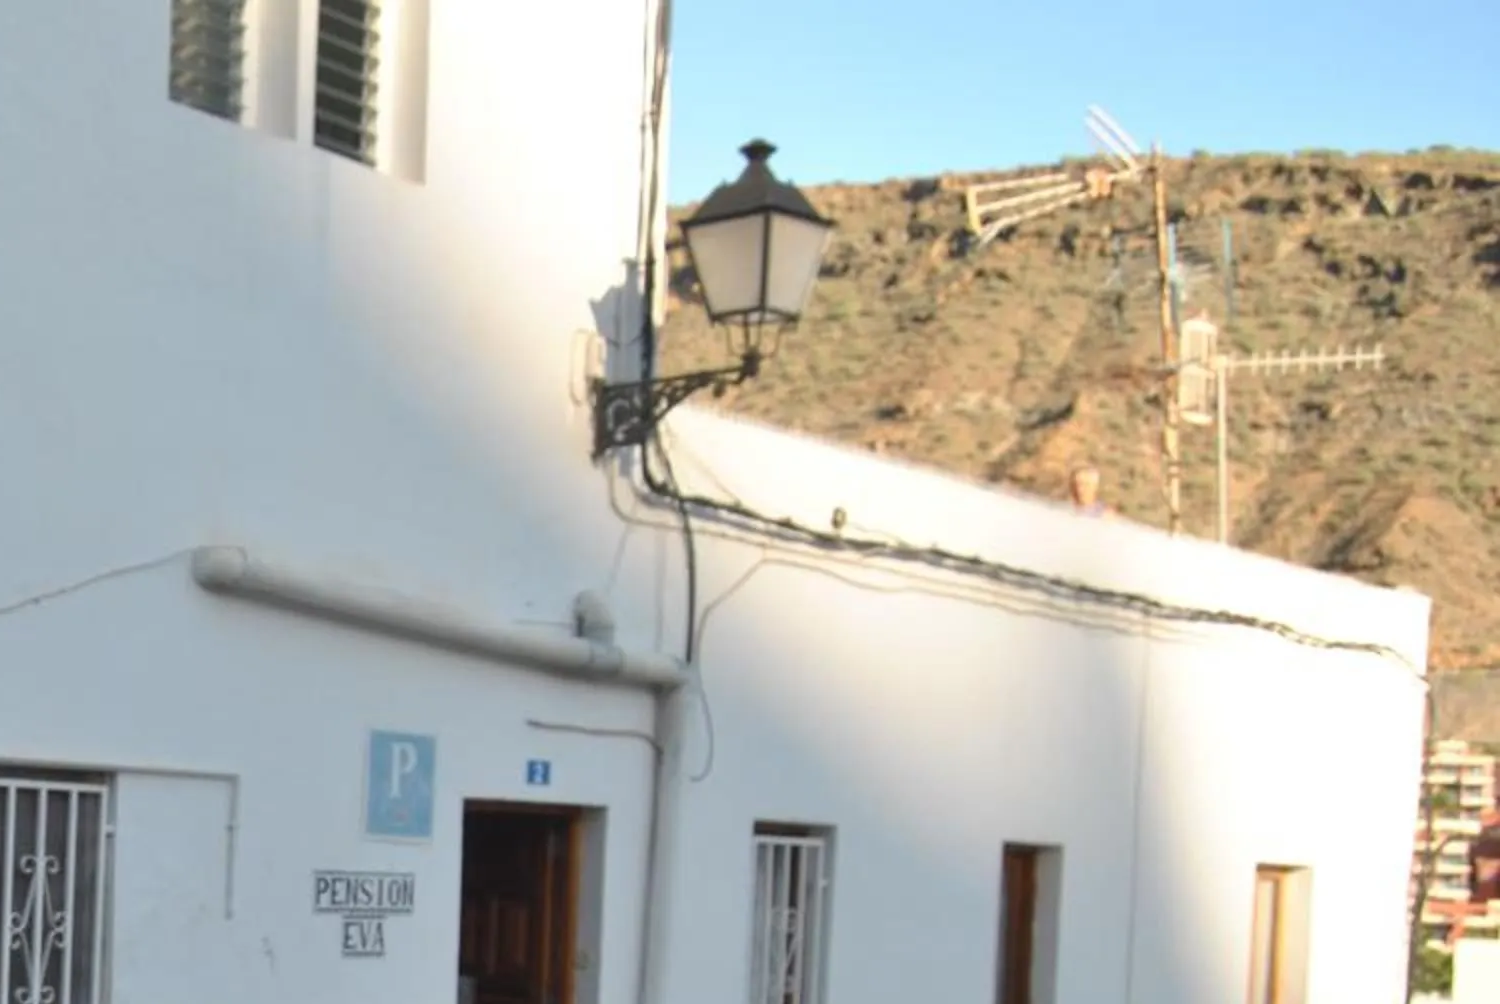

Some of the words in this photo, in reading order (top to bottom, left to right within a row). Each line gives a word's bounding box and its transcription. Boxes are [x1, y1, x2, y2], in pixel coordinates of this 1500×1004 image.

[389, 741, 418, 798] P
[315, 876, 414, 906] PENSION
[342, 920, 385, 950] EVA
